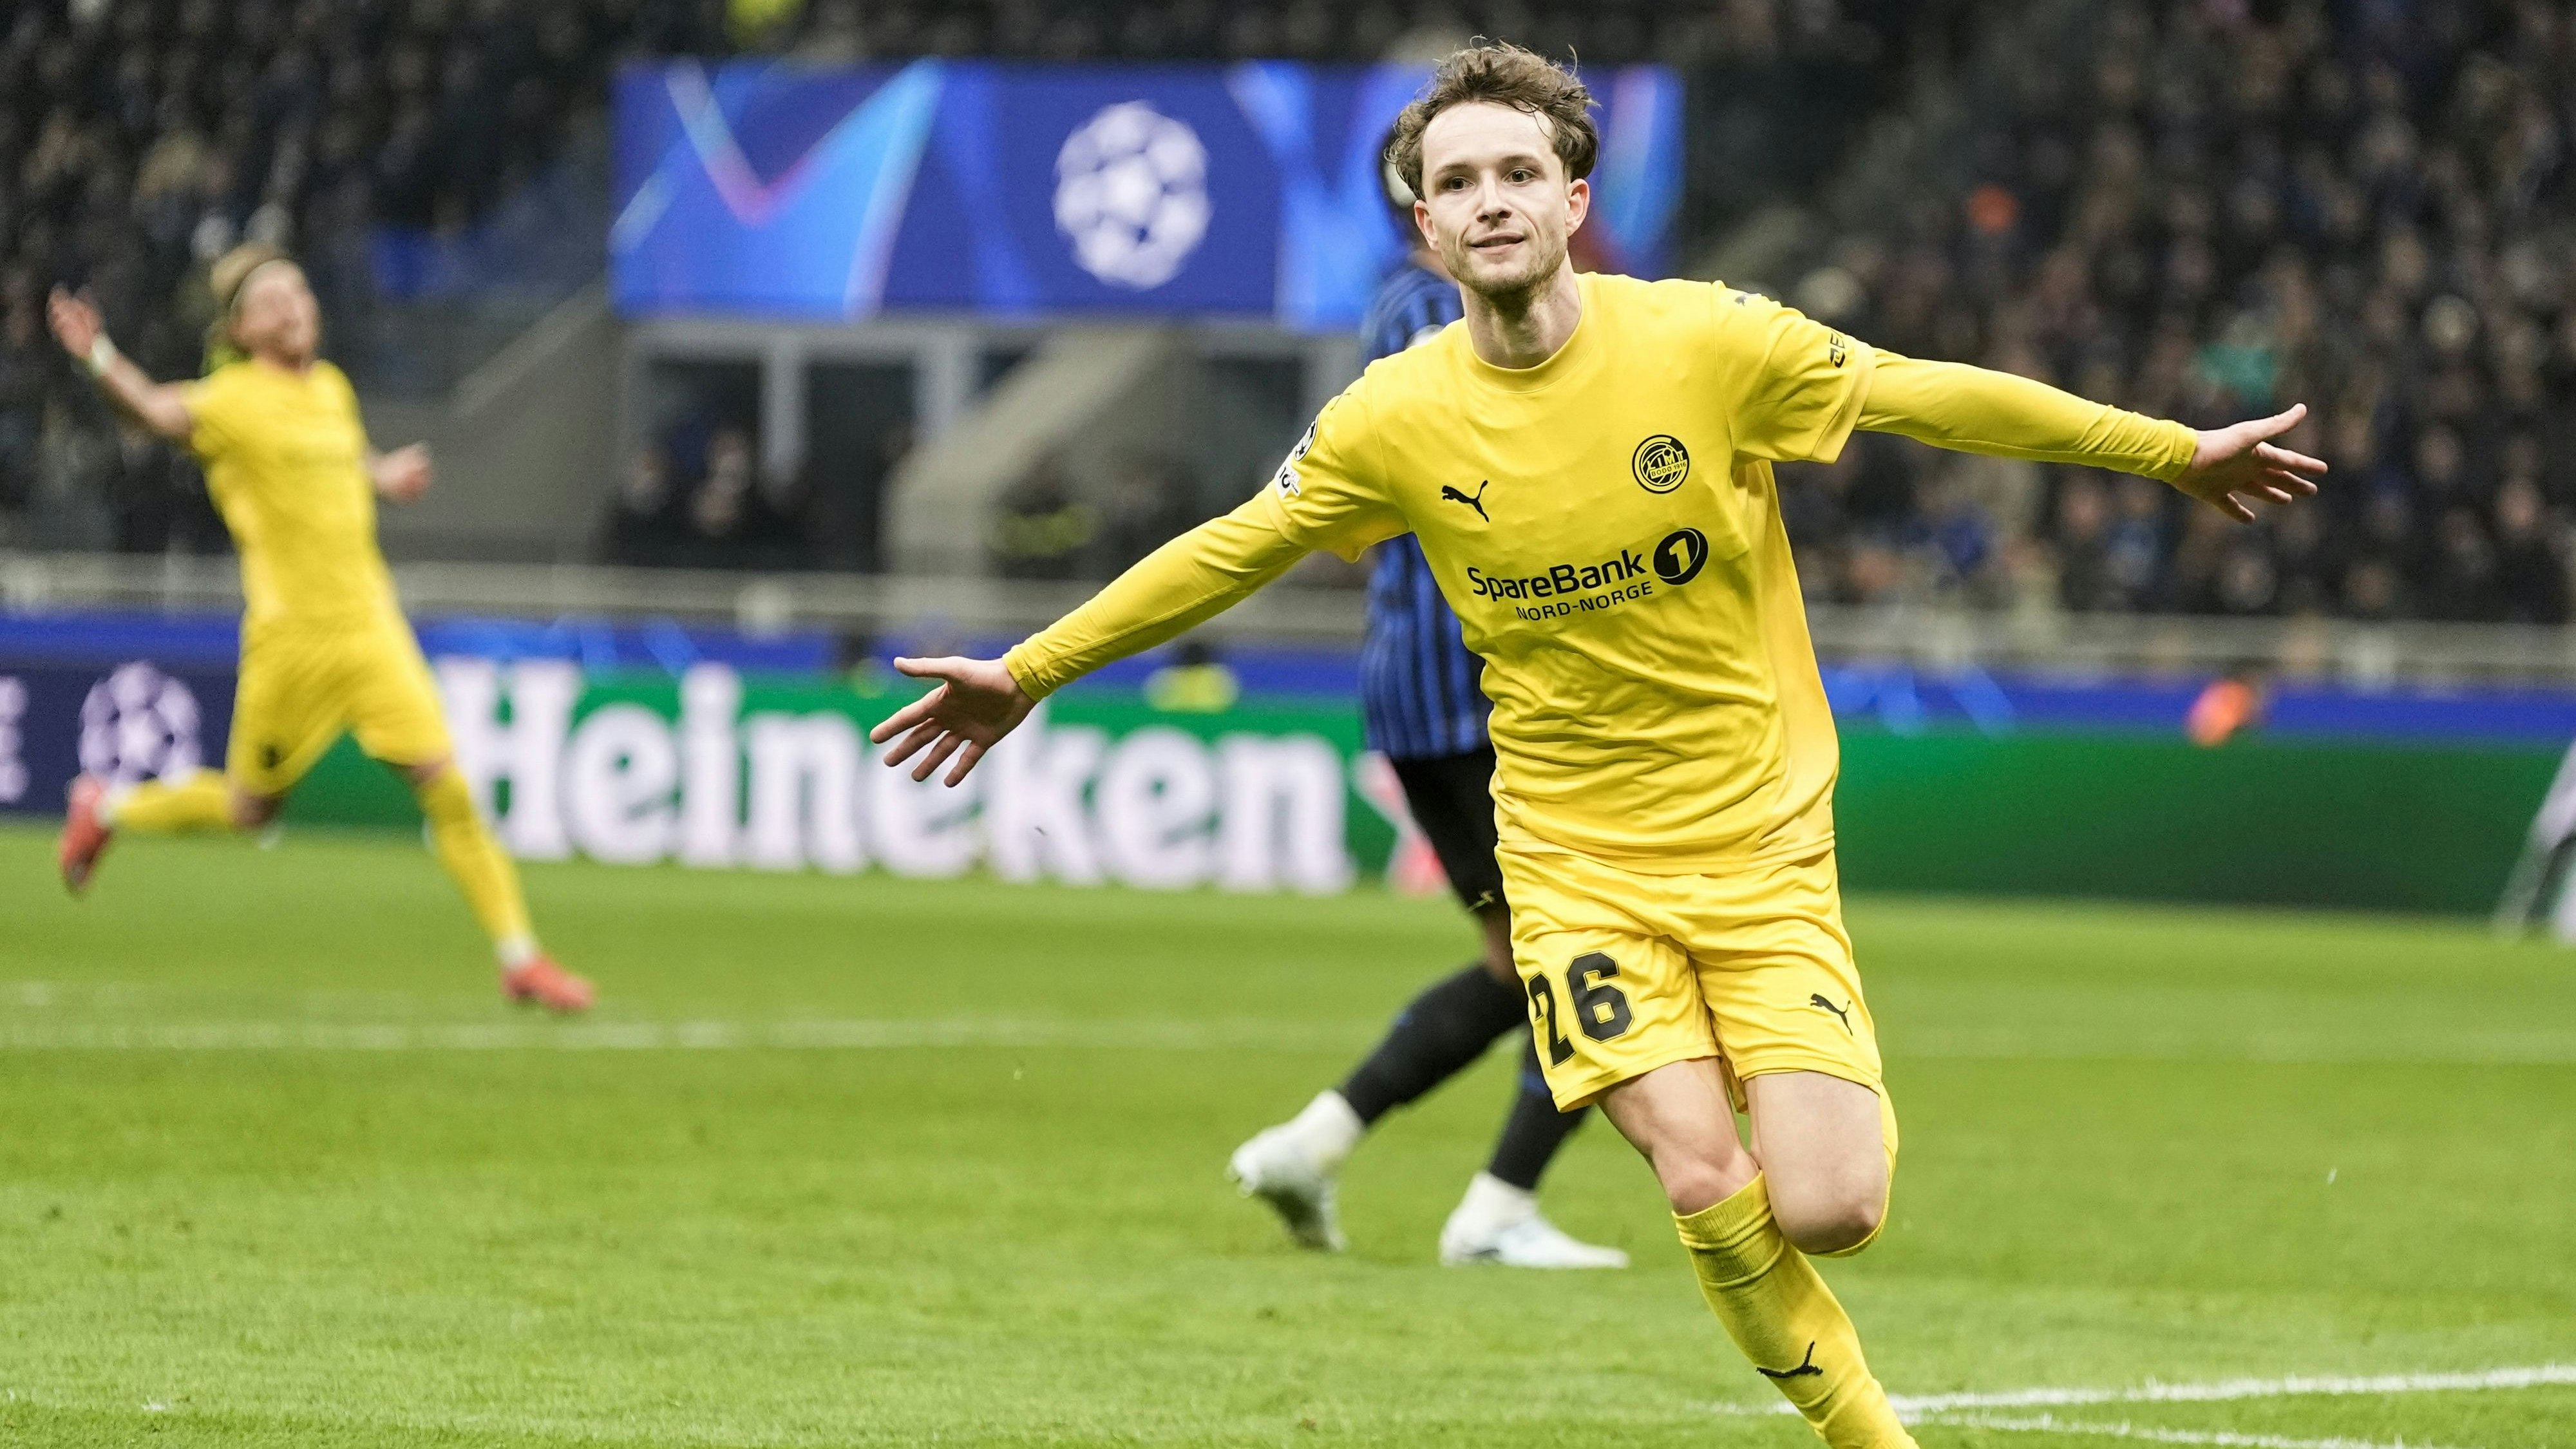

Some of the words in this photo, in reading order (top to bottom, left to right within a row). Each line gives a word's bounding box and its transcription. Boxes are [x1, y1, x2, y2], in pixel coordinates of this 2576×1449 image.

[1467, 549, 1647, 601] SpareBank
[1516, 582, 1653, 621] NORD-NORGE
[1528, 950, 1635, 1068] 26
